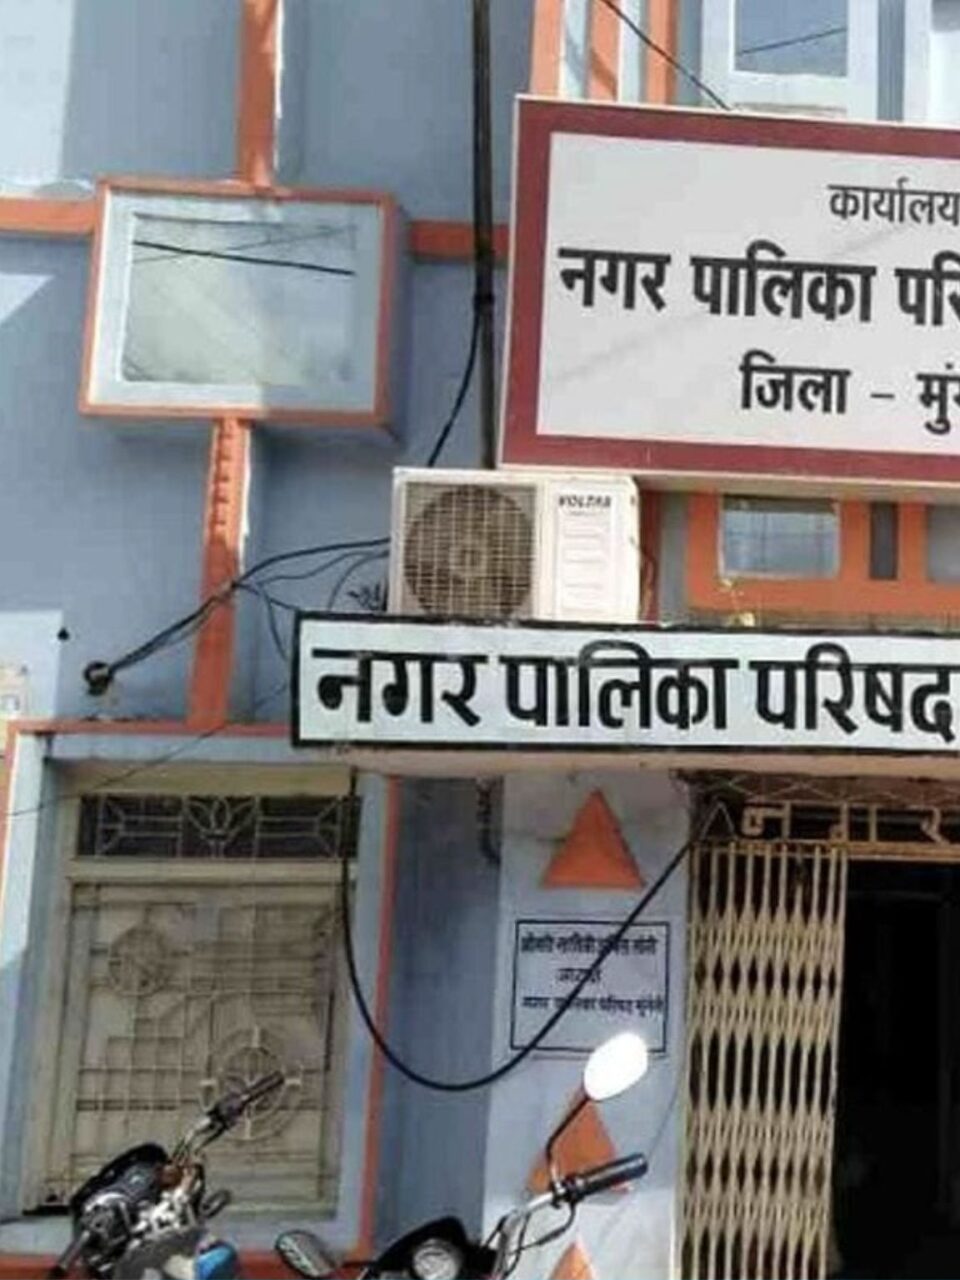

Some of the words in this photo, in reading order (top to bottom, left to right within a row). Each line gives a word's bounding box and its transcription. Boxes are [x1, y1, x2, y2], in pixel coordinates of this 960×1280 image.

[557, 246, 672, 311] नगर
[689, 239, 877, 322] पालिका
[738, 349, 851, 415] जिला
[311, 648, 489, 727] नगर
[499, 639, 740, 730] पालिका
